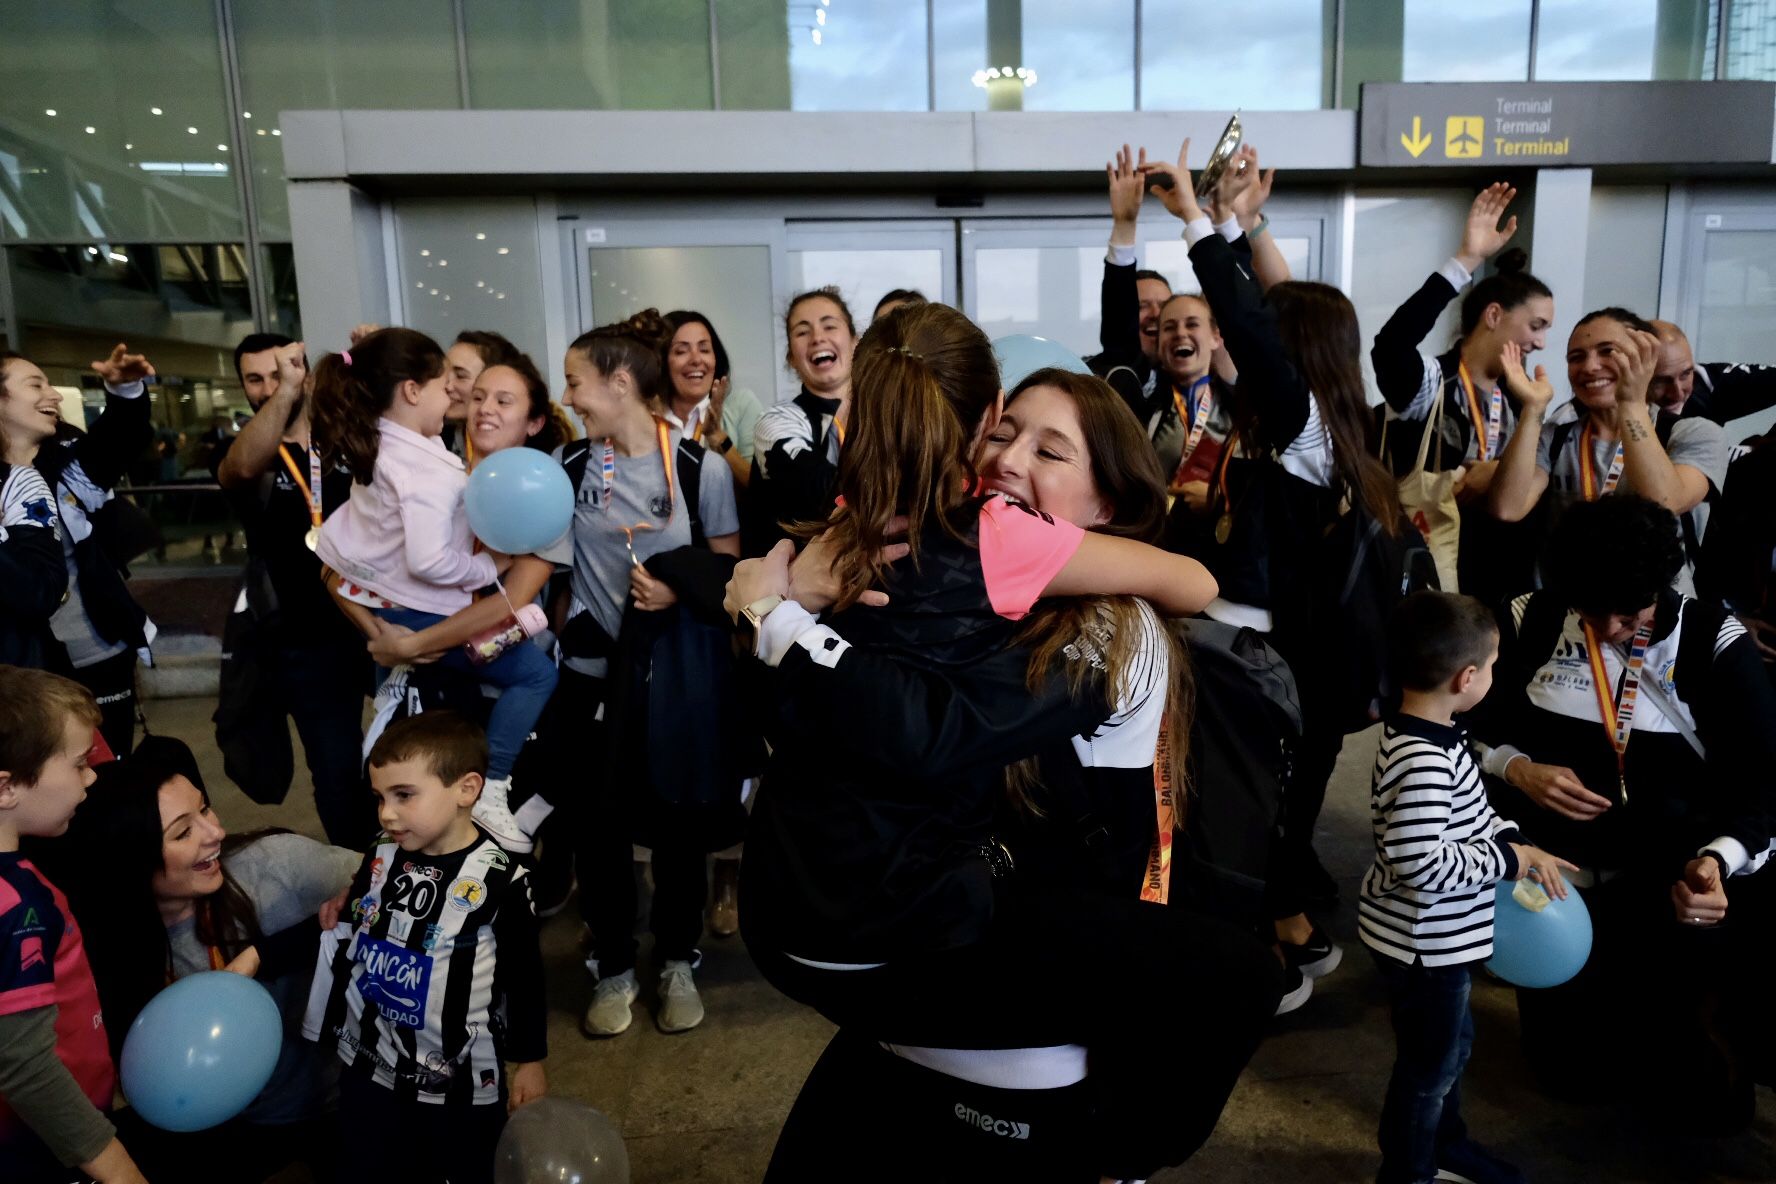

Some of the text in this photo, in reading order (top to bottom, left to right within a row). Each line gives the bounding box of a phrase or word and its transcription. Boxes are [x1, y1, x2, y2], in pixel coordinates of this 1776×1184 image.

[1496, 98, 1553, 114] Terminal
[1495, 118, 1551, 134] Terminal
[1494, 137, 1569, 156] Terminal
[386, 873, 438, 920] 20
[954, 1102, 1009, 1137] emec
